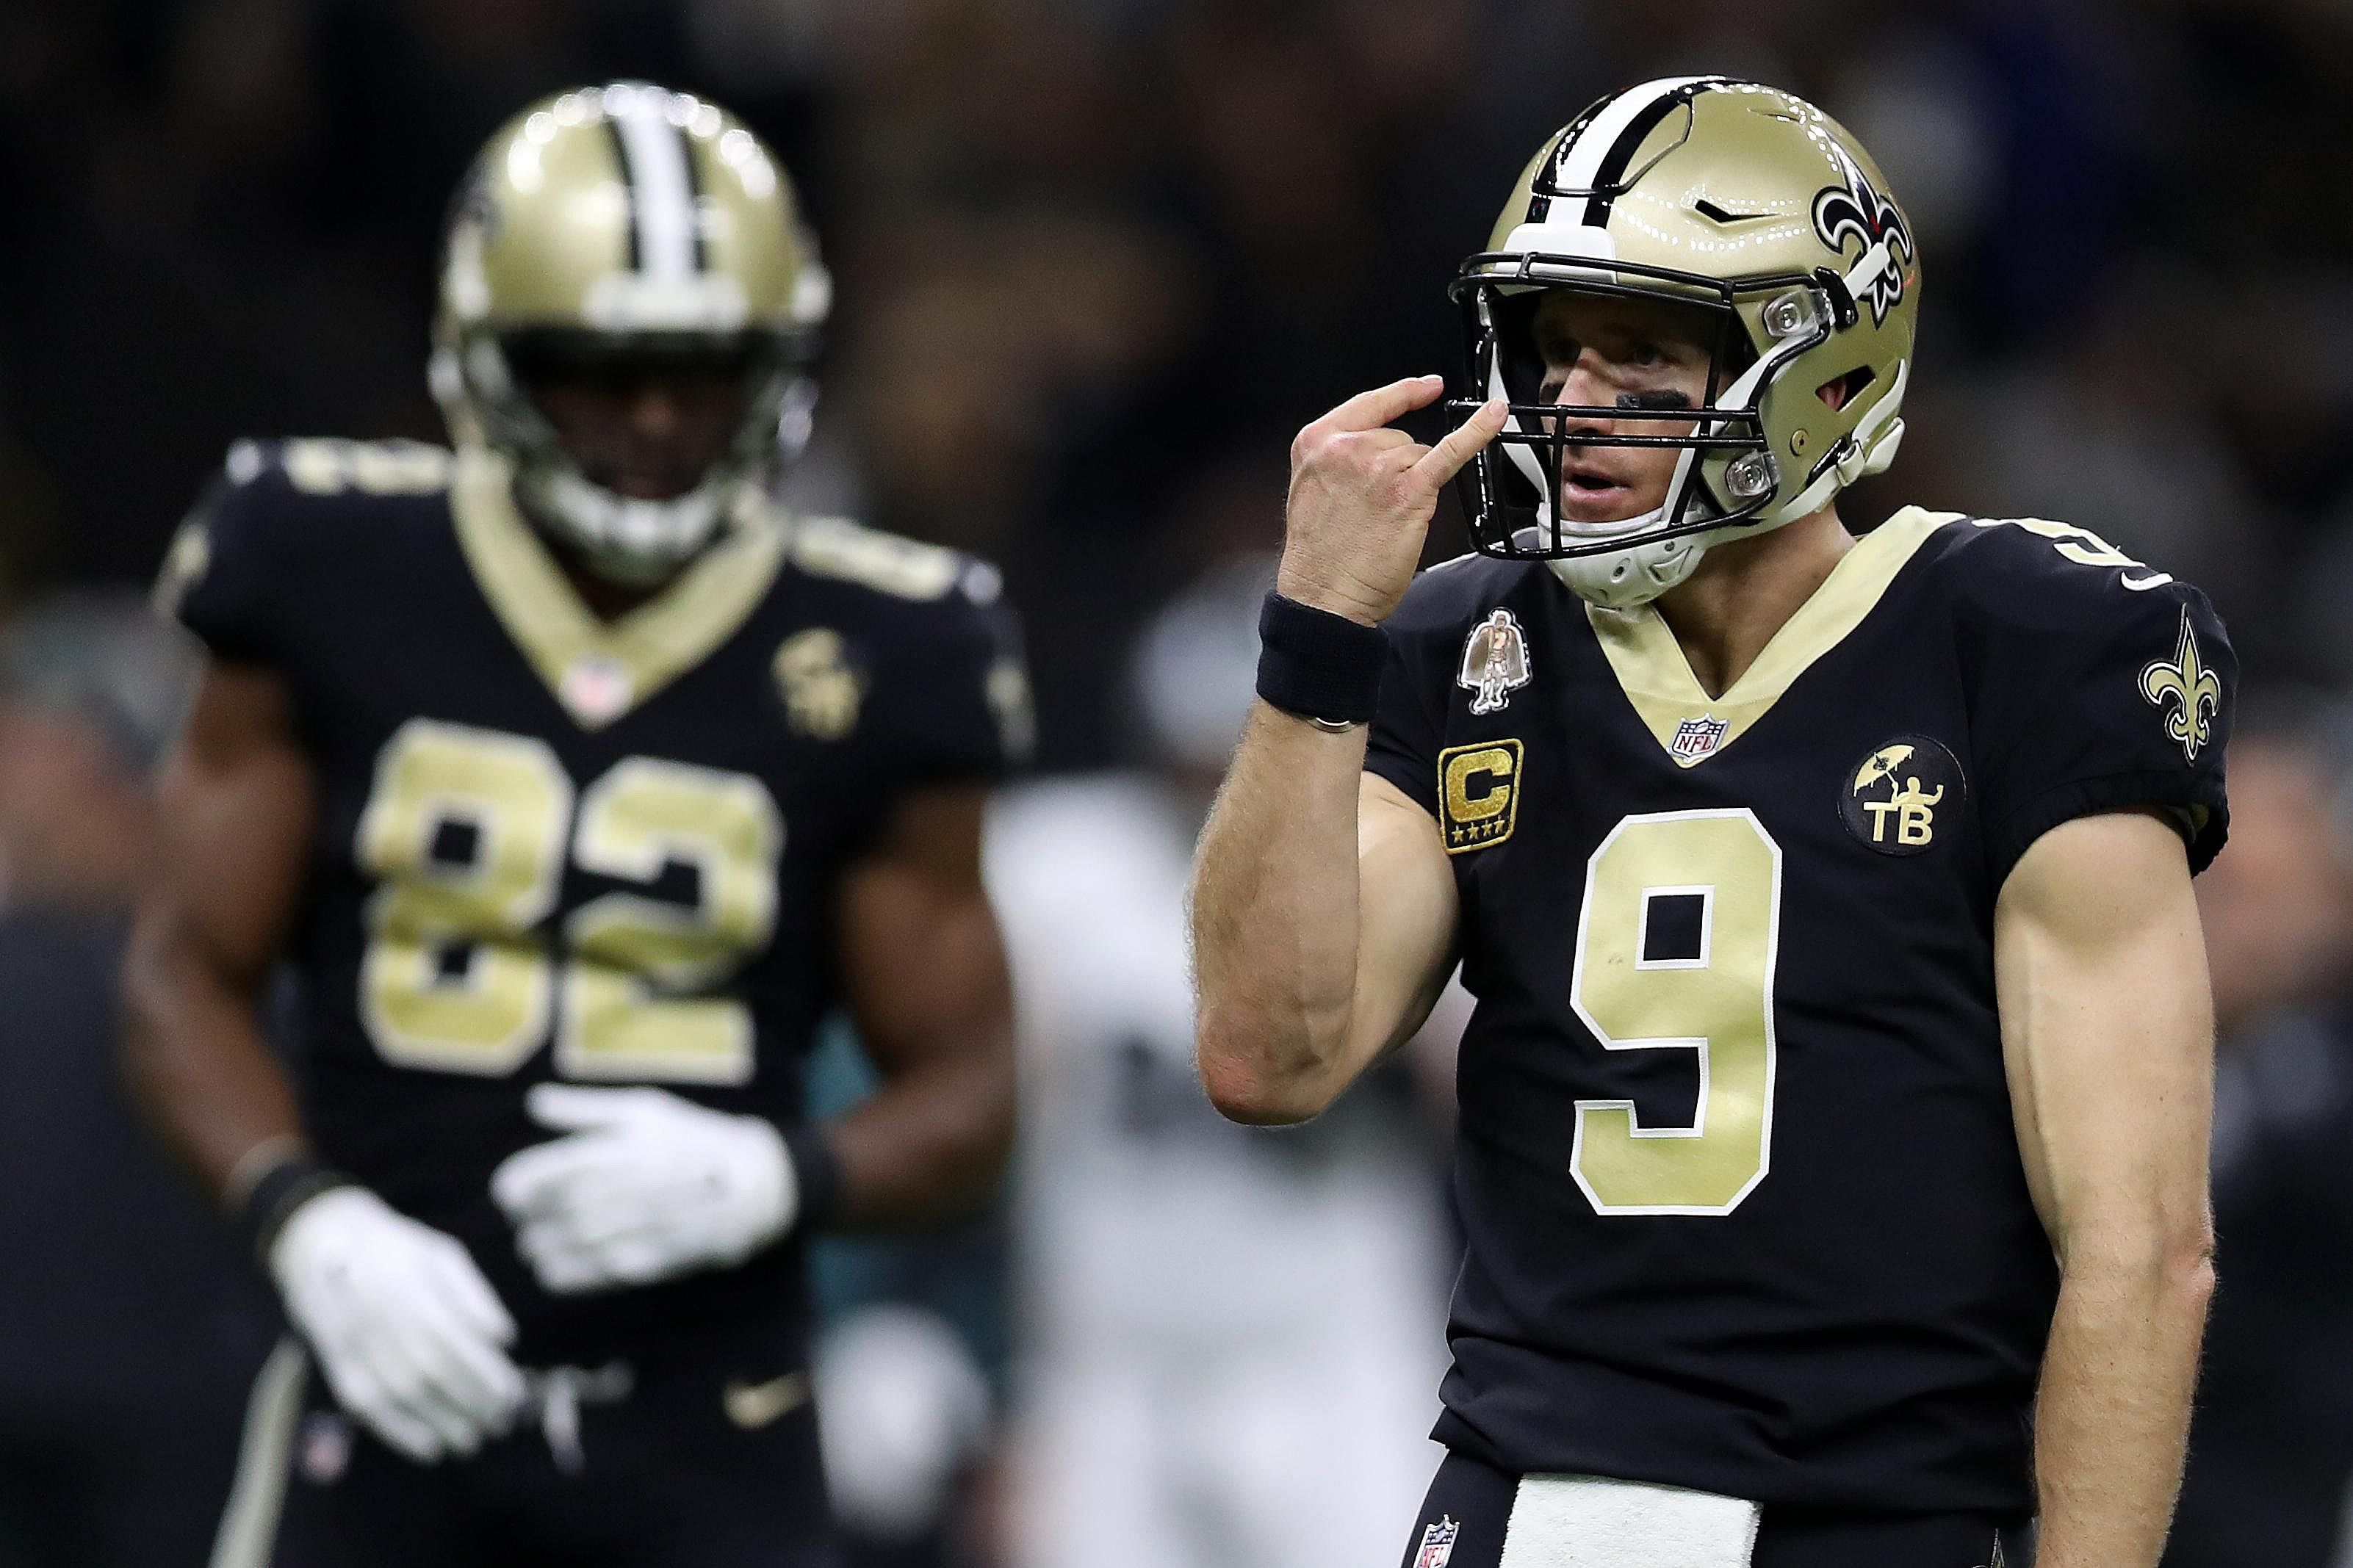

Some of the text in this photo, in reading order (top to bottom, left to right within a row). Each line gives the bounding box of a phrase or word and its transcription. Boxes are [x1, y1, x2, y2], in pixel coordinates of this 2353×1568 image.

[1676, 735, 1712, 753] NFL
[1446, 748, 1513, 823] C
[1863, 801, 1934, 845] TB
[356, 717, 785, 1085] 82
[1569, 807, 1783, 1216] 9
